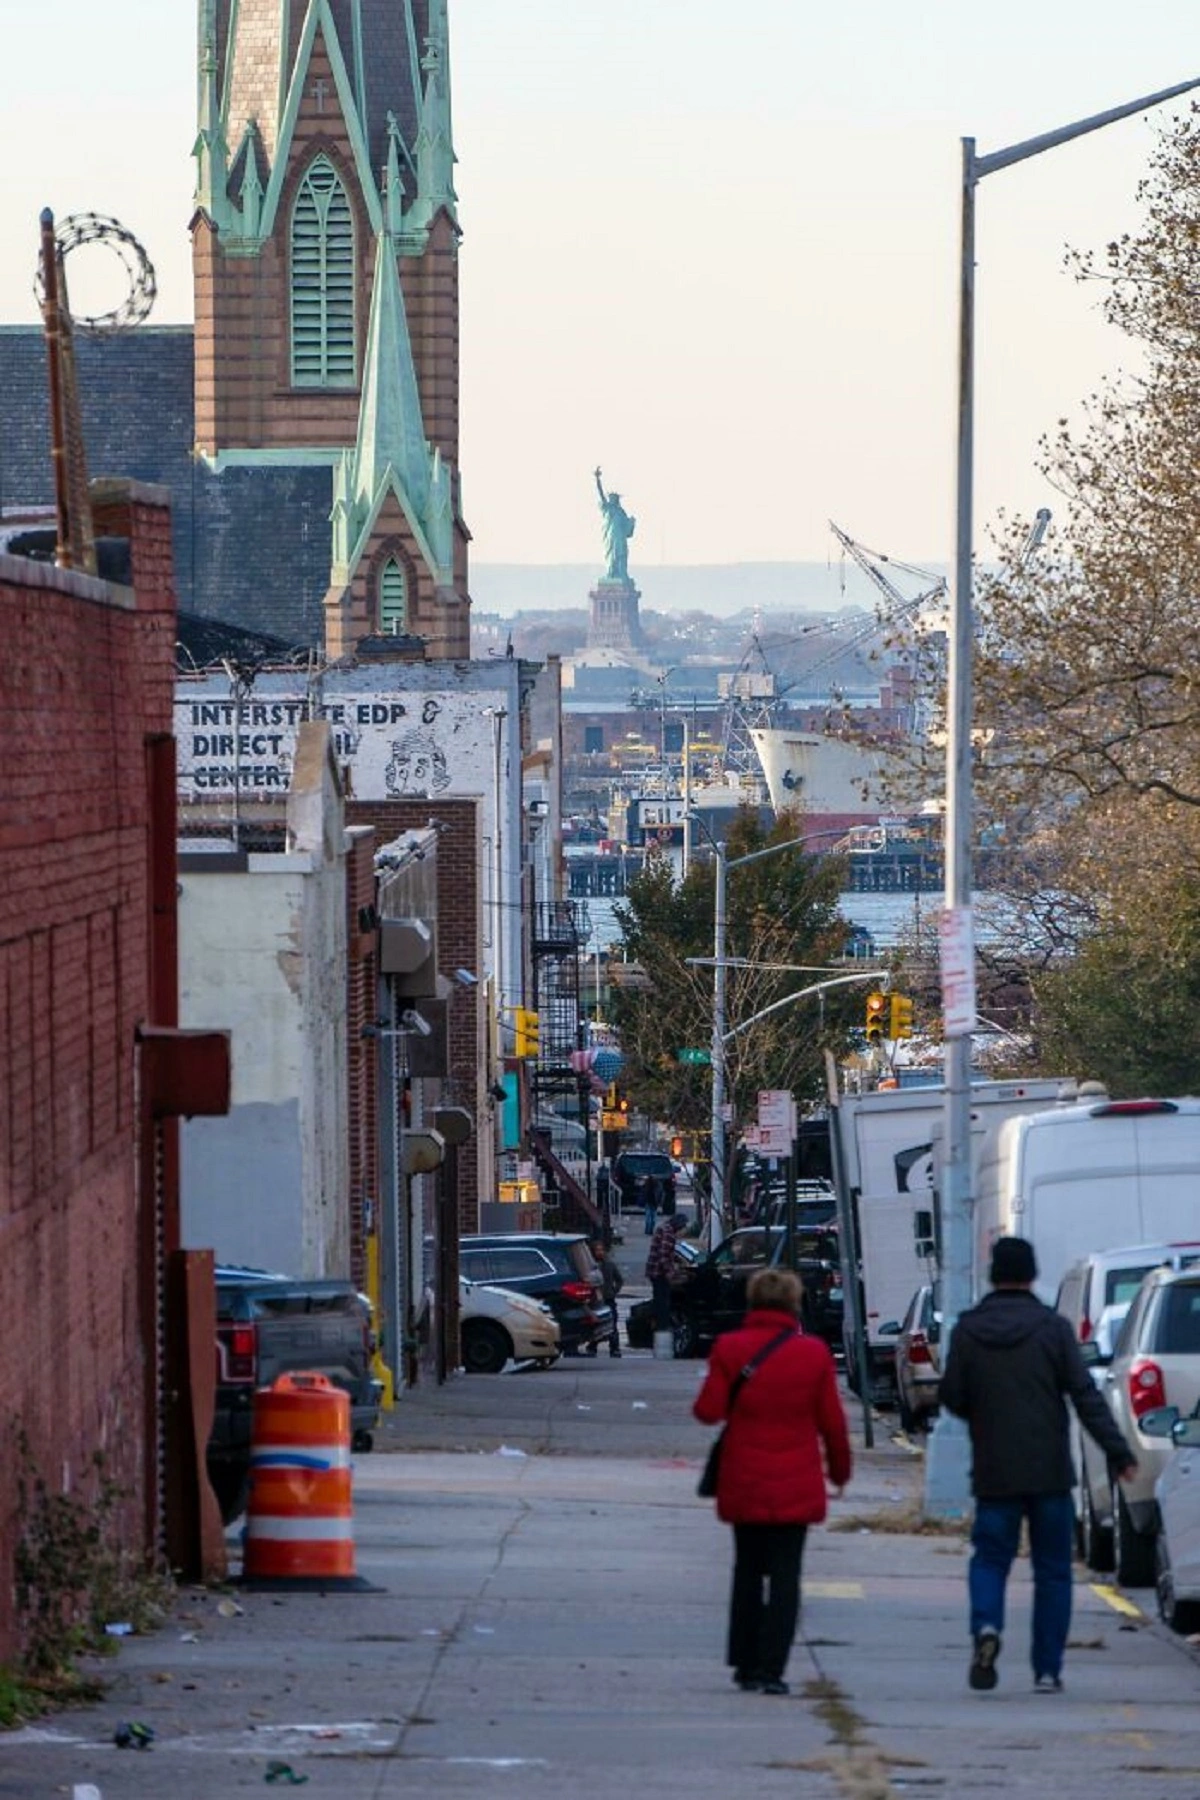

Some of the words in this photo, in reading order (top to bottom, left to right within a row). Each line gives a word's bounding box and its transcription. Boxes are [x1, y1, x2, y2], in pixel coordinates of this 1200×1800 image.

[357, 704, 406, 724] EDP
[422, 700, 441, 724] &
[193, 735, 283, 756] DIRECT
